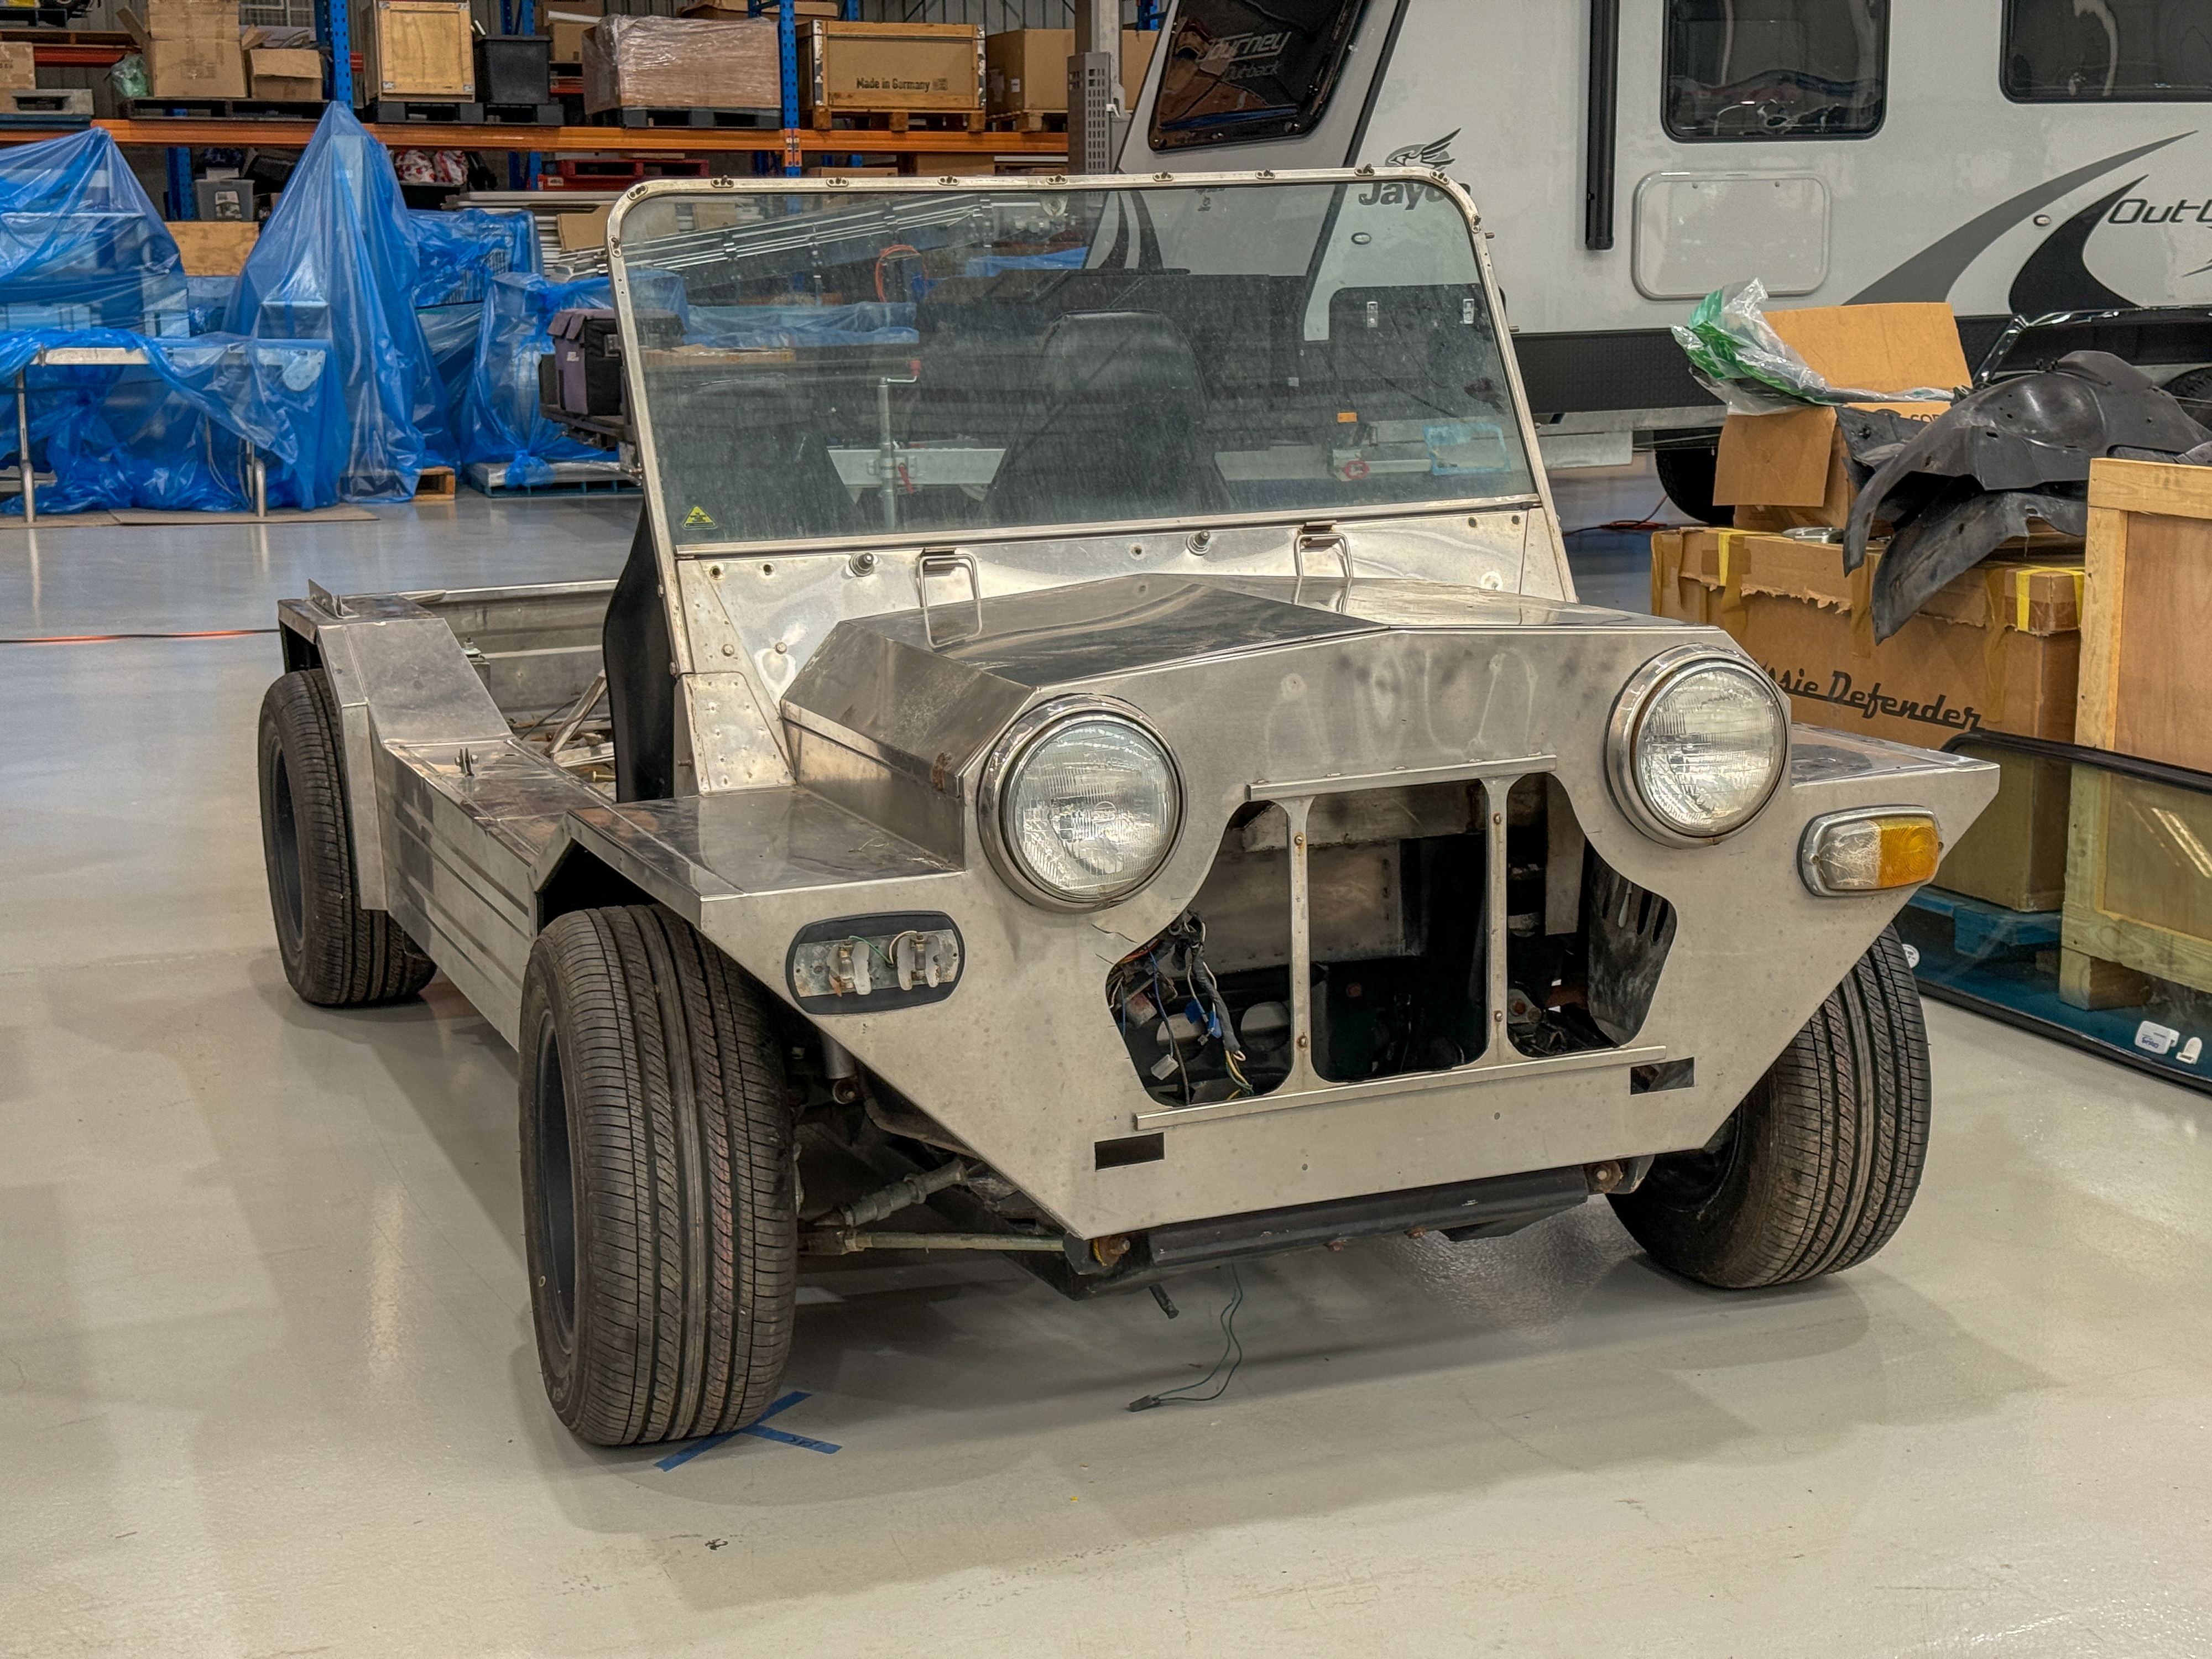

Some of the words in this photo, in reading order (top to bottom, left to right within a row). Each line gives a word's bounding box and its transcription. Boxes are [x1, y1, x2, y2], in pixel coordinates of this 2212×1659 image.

[1195, 32, 1292, 63] Journey
[857, 77, 880, 88] Made
[882, 77, 890, 89] in
[892, 78, 930, 93] Germany
[1827, 670, 1981, 731] Defender
